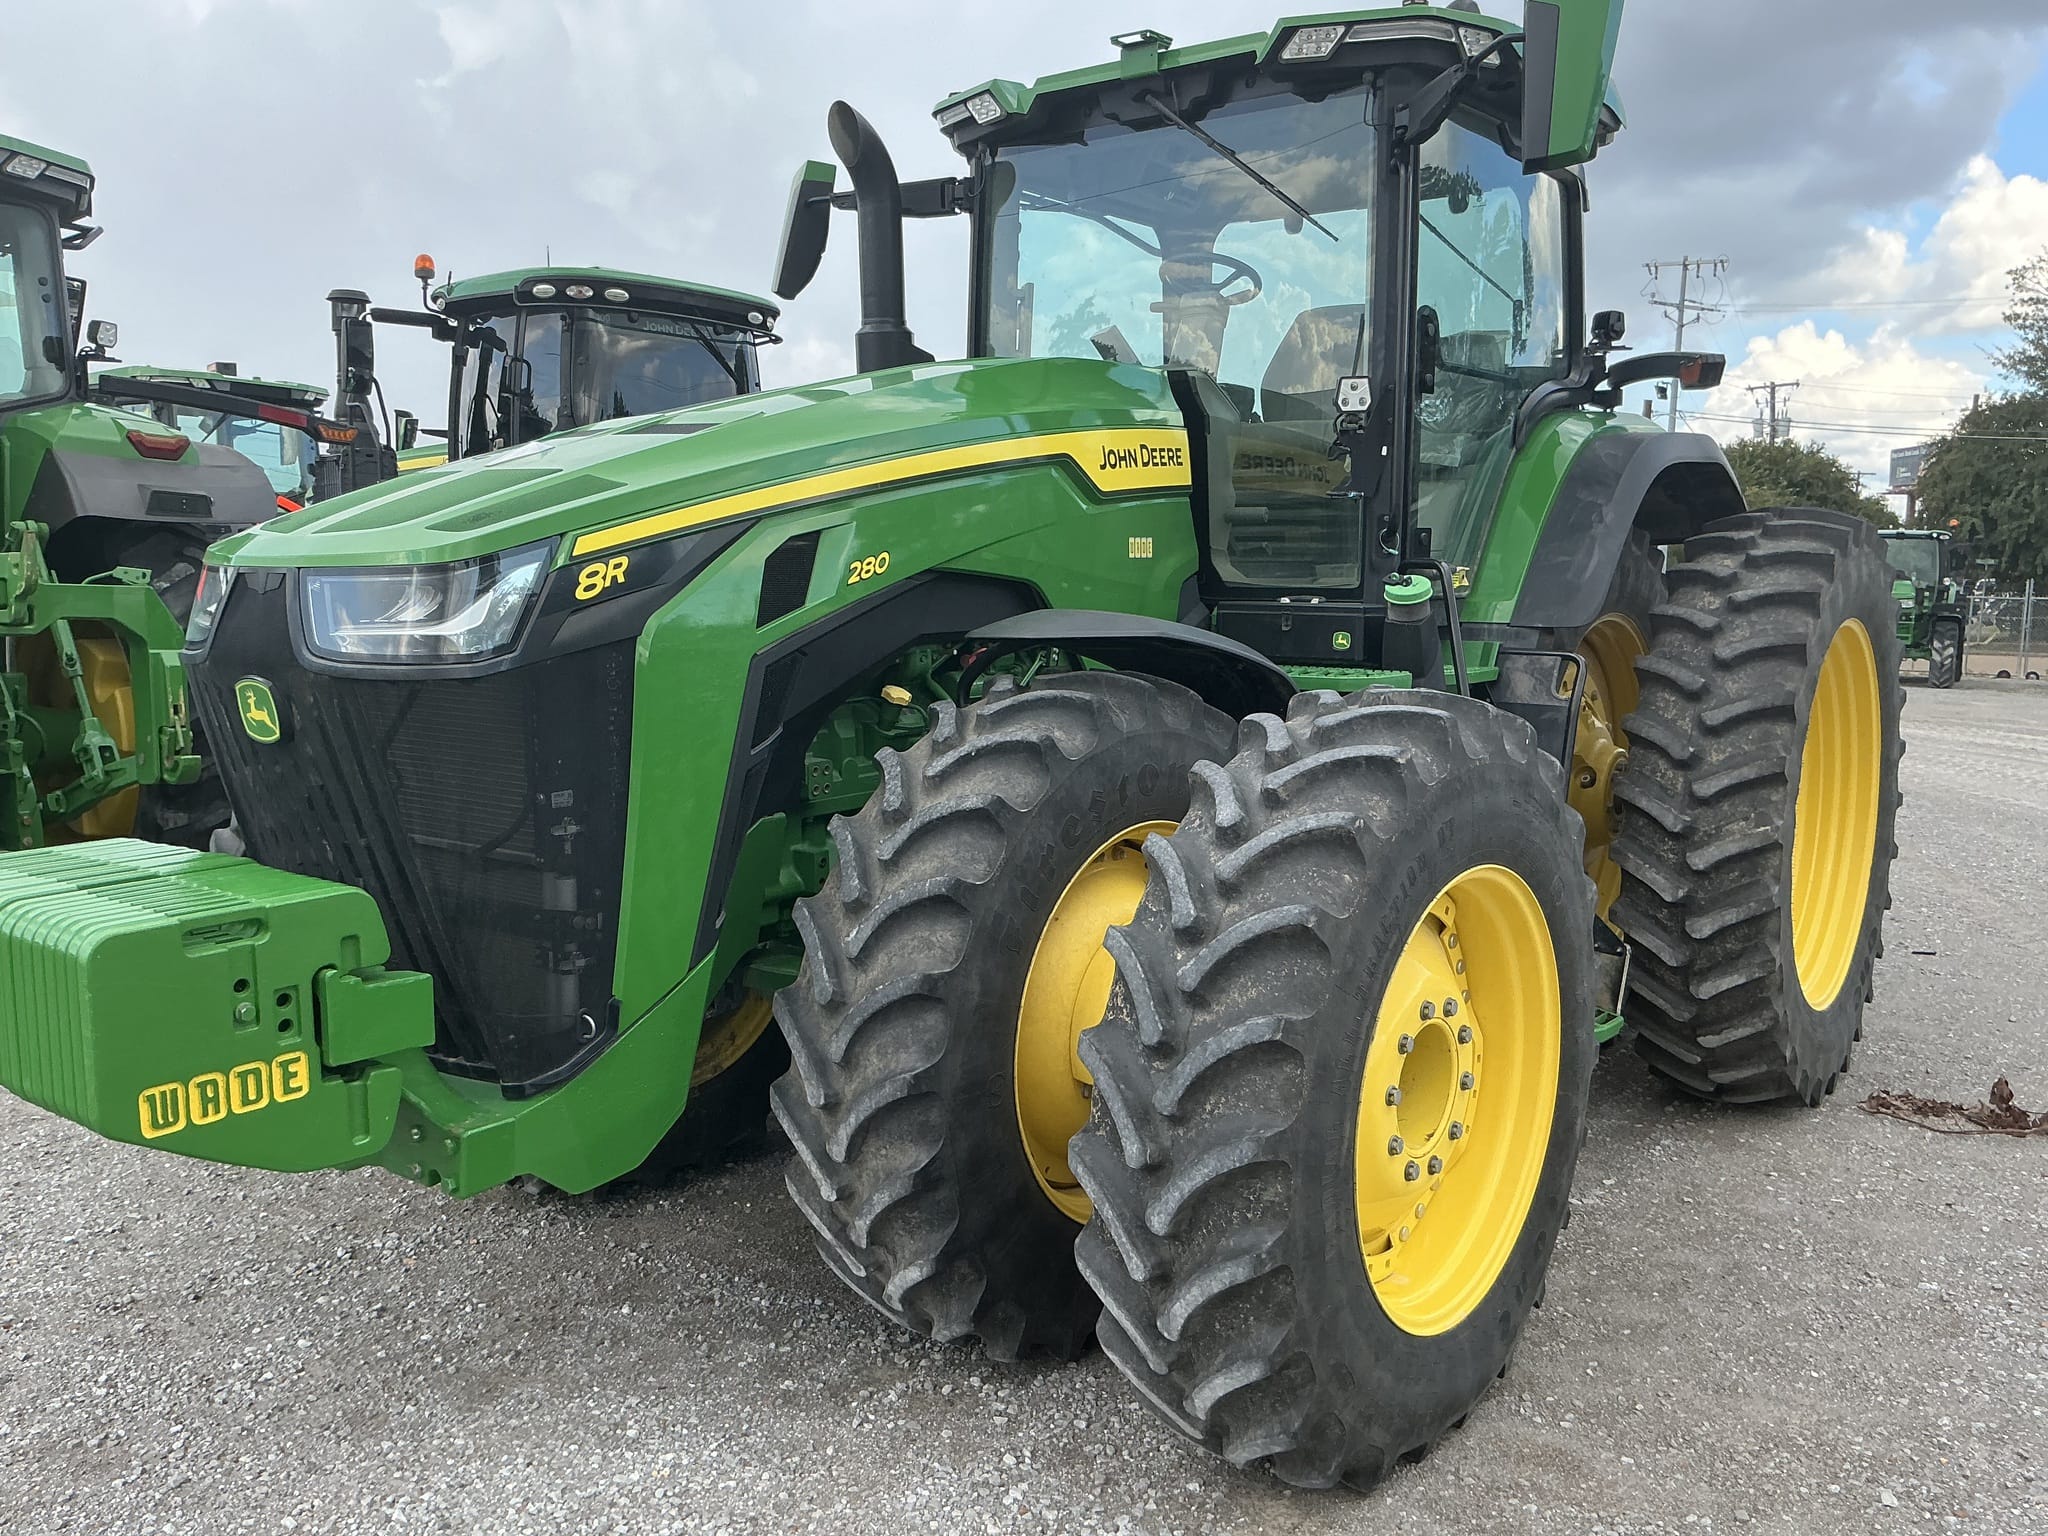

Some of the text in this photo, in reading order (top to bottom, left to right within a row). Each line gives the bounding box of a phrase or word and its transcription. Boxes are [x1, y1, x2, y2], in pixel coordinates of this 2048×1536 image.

[643, 321, 674, 334] JOHN
[1100, 444, 1183, 470] JOHN DEERE
[575, 556, 629, 600] 8R
[847, 551, 890, 585] 280
[140, 1052, 308, 1138] WADE
